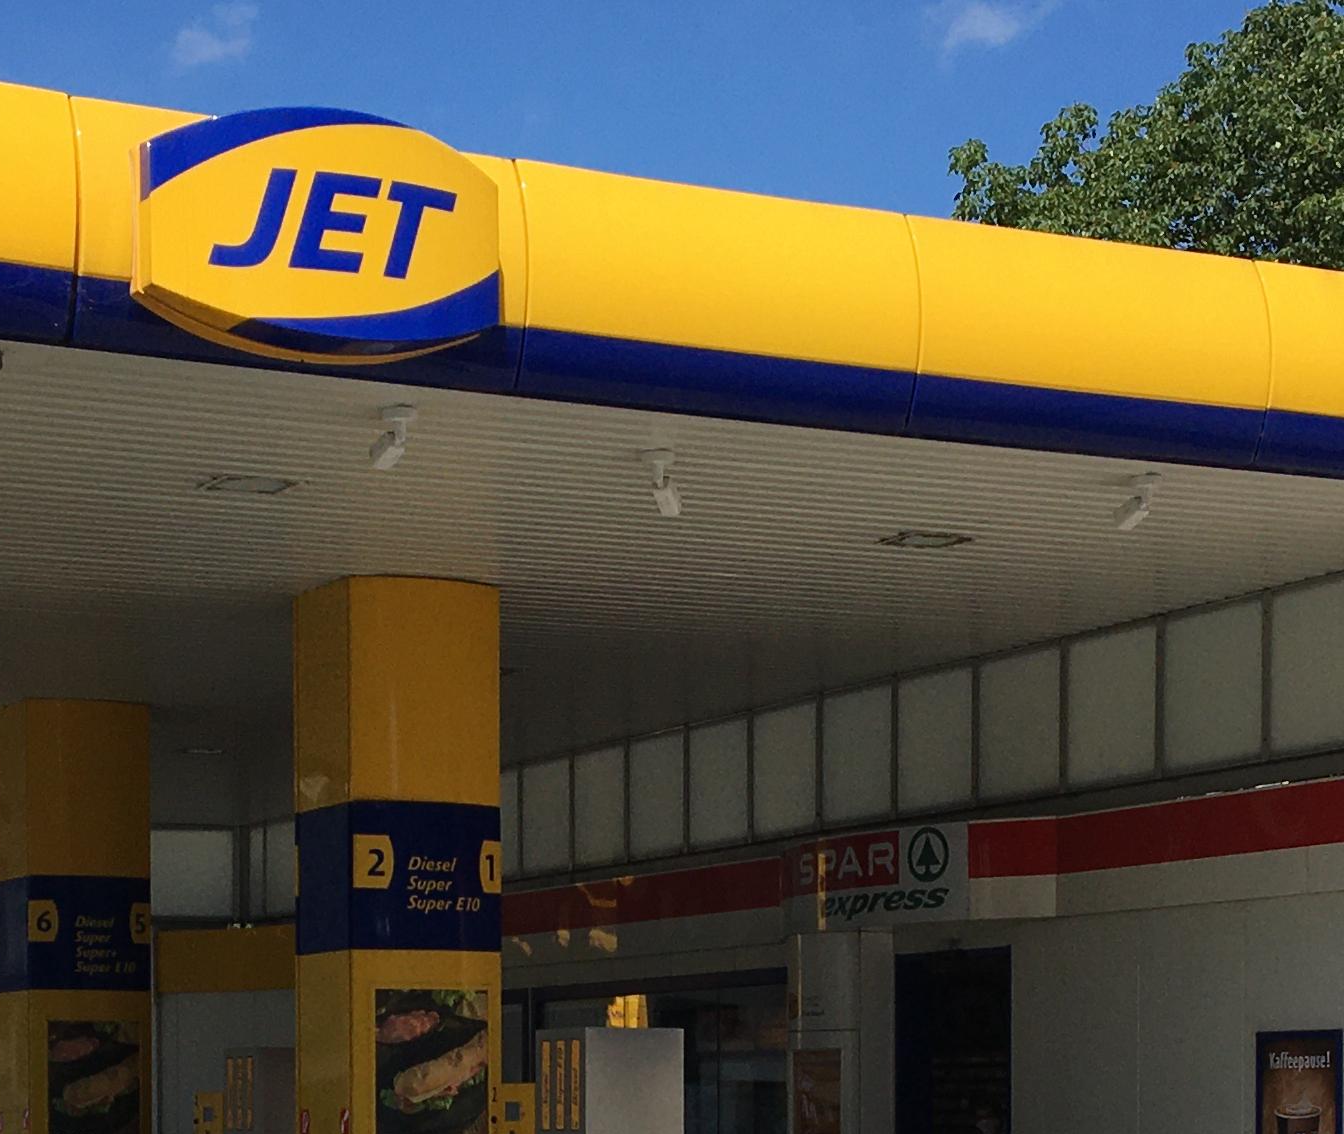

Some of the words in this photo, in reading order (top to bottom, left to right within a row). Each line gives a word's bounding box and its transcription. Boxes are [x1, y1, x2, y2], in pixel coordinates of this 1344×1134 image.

[208, 168, 457, 279] JET
[368, 849, 385, 876] 2
[408, 856, 457, 873] Diesel
[485, 855, 495, 881] 1
[799, 841, 895, 886] SPAR
[407, 875, 453, 895] Super
[407, 895, 452, 915] Super
[456, 897, 480, 912] E10
[824, 888, 949, 920] express
[37, 911, 51, 932] 6
[135, 914, 146, 933] 5
[75, 930, 111, 945] Super
[75, 961, 111, 975] Super
[1269, 1051, 1331, 1072] Kaffeepause!
